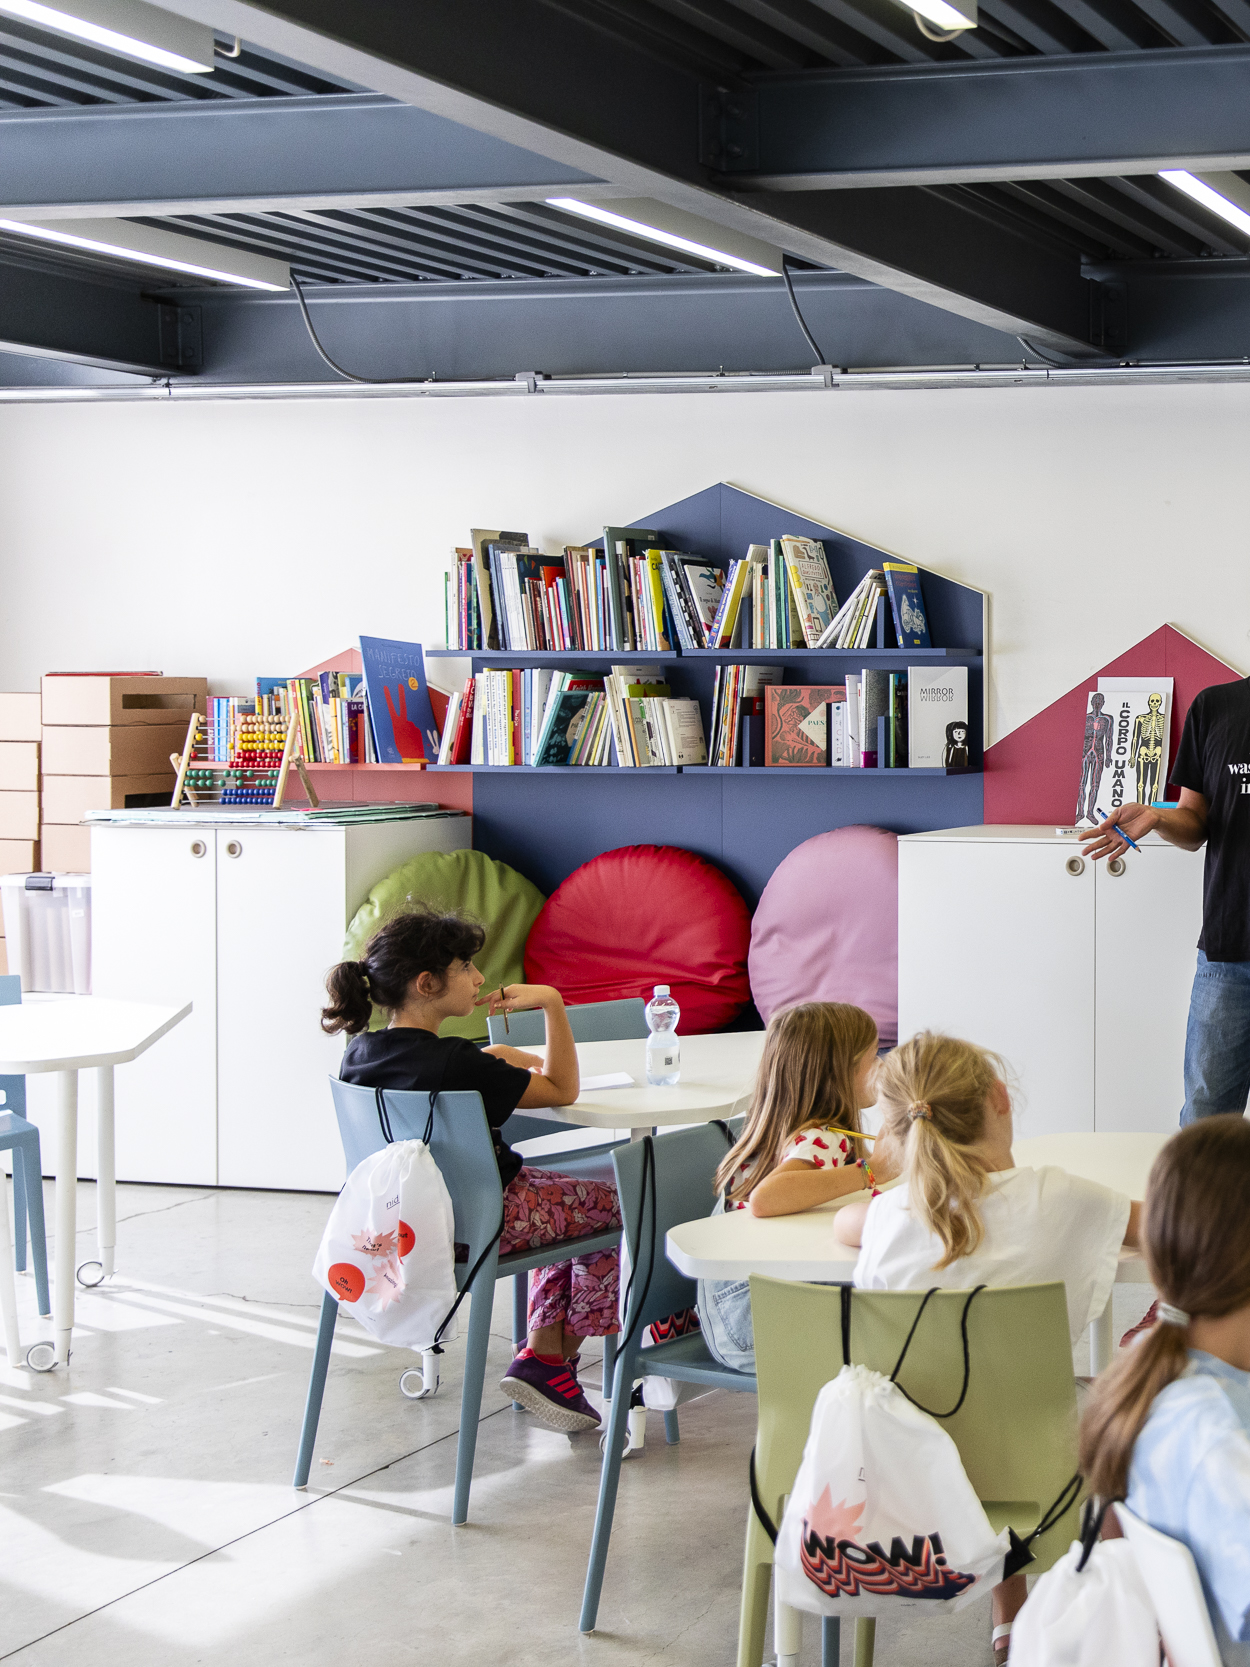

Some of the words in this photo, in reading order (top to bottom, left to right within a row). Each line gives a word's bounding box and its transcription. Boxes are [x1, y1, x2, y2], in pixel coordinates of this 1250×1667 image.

[366, 648, 420, 666] MANIFESTO
[379, 665, 417, 680] SEGRETO
[410, 679, 418, 688] 2
[1115, 710, 1131, 756] CORPO
[1111, 760, 1127, 808] UMANO
[802, 1521, 950, 1580] WOW!
